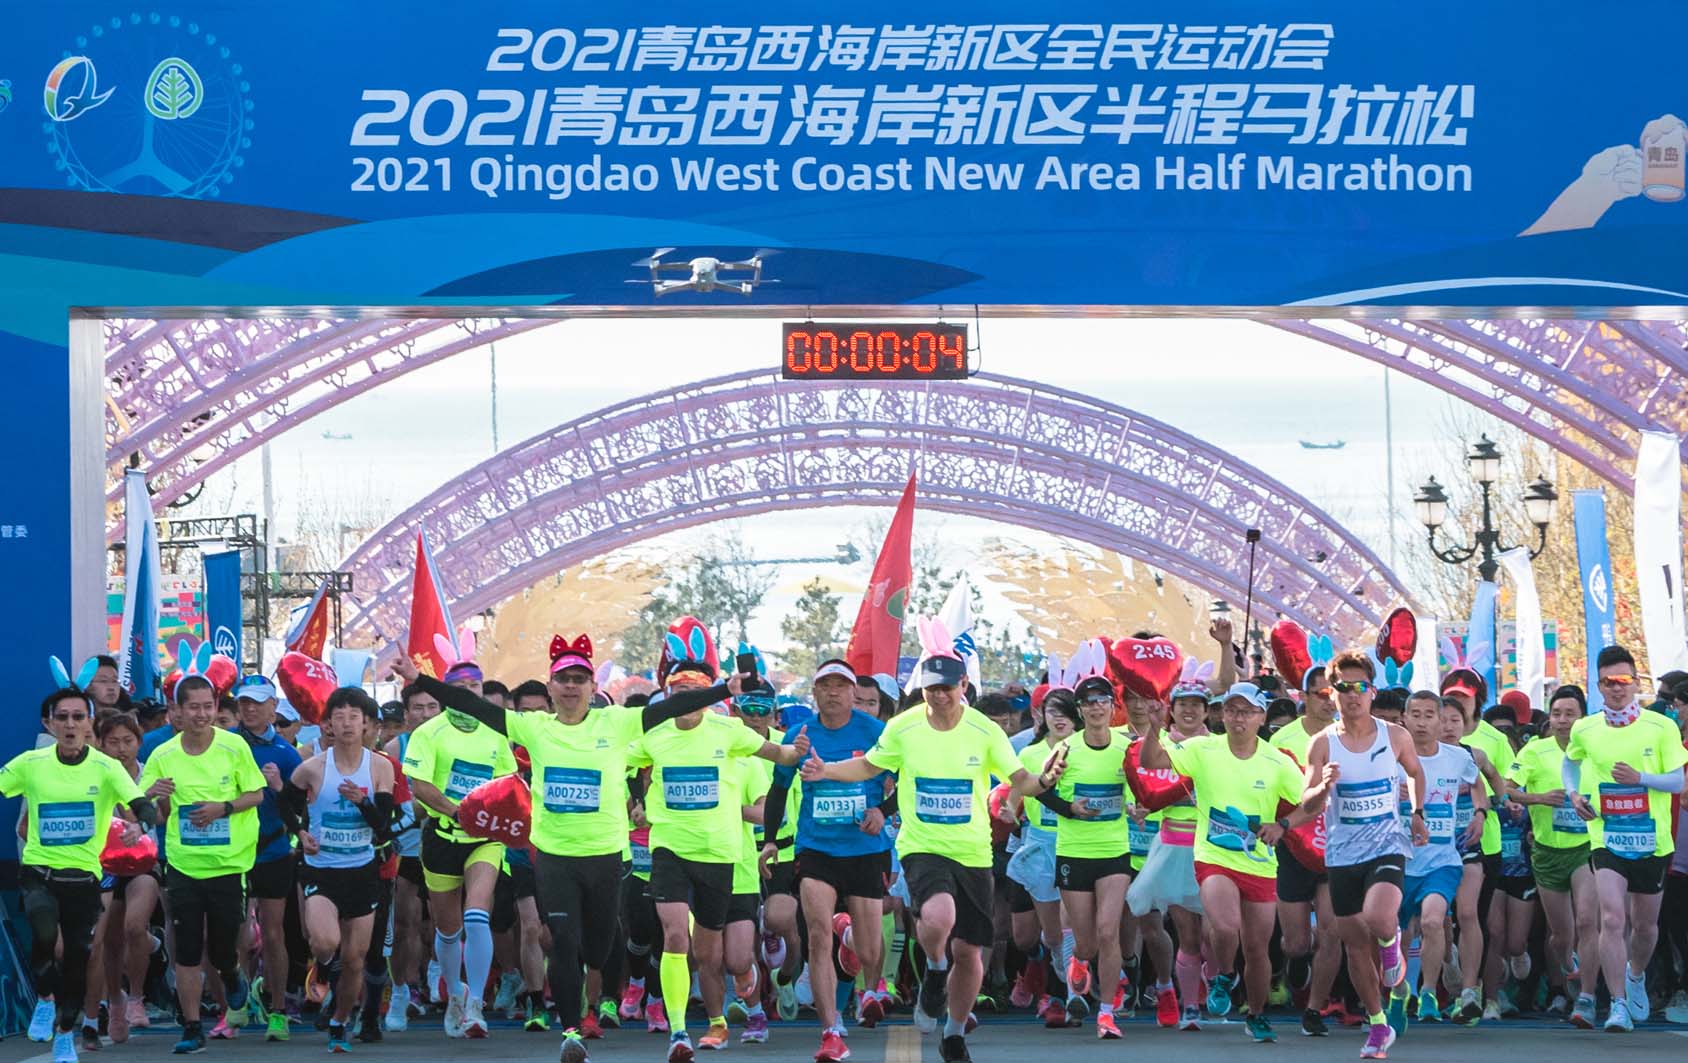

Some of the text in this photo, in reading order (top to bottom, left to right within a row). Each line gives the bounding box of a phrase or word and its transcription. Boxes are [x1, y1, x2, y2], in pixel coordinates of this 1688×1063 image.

[487, 24, 1334, 72] 2021青岛西海岸新区全民运动会
[351, 84, 1475, 146] 2021青岛西海岸新区半程马拉松
[351, 154, 1472, 200] 2021 Qingdao West Coast New Area Half Marathon
[787, 331, 963, 373] 00:00:04
[1132, 643, 1176, 660] 2:45
[304, 661, 337, 685] 2:15
[547, 785, 590, 800] A00725
[667, 784, 709, 797] A01308
[920, 795, 962, 809] A01806
[1342, 798, 1384, 812] A05355
[43, 820, 85, 832] A00500
[474, 809, 524, 837] 3:15
[324, 830, 362, 842] A00169
[1607, 834, 1647, 846] A02010
